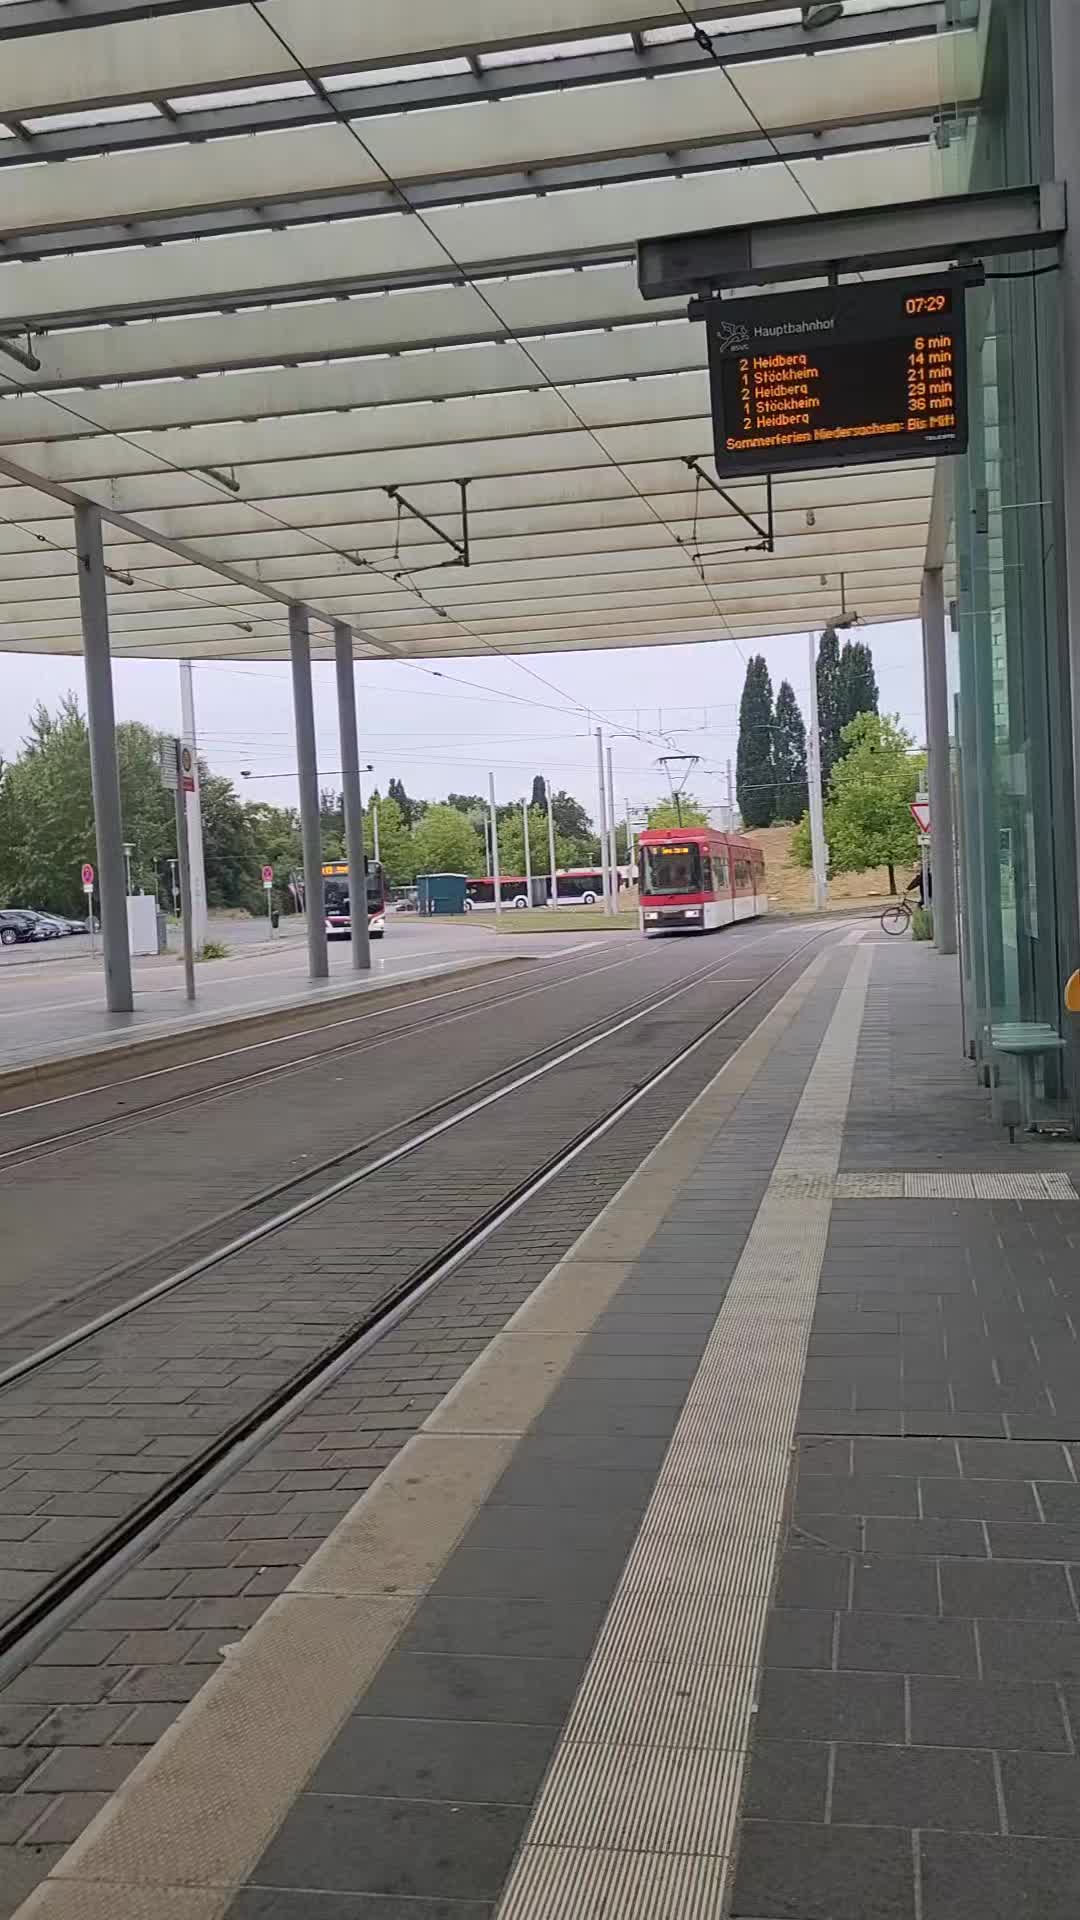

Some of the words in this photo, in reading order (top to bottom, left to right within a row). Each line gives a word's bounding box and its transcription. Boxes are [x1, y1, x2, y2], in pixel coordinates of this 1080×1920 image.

[906, 296, 945, 314] 07:29
[754, 319, 834, 337] Hauptbahnhof
[739, 358, 749, 371] 2
[753, 354, 807, 369] Heidberg
[914, 337, 924, 350] 6
[928, 336, 951, 348] min
[742, 373, 748, 385] 1
[754, 366, 819, 384] Stöckheim
[908, 352, 924, 366] 14
[928, 350, 951, 363] min
[741, 388, 750, 400] 2
[755, 384, 808, 398] Heidberg
[907, 369, 924, 381] 21
[929, 365, 952, 378] min
[744, 402, 750, 414] 1
[755, 396, 820, 413] Stöckheim
[907, 383, 925, 396] 29
[929, 380, 952, 394] min
[743, 417, 752, 430] 2
[756, 413, 809, 428] Heidberg
[907, 398, 926, 411] 36
[929, 396, 952, 408] min
[726, 431, 812, 450] Sommerferien
[907, 418, 927, 431] Bis
